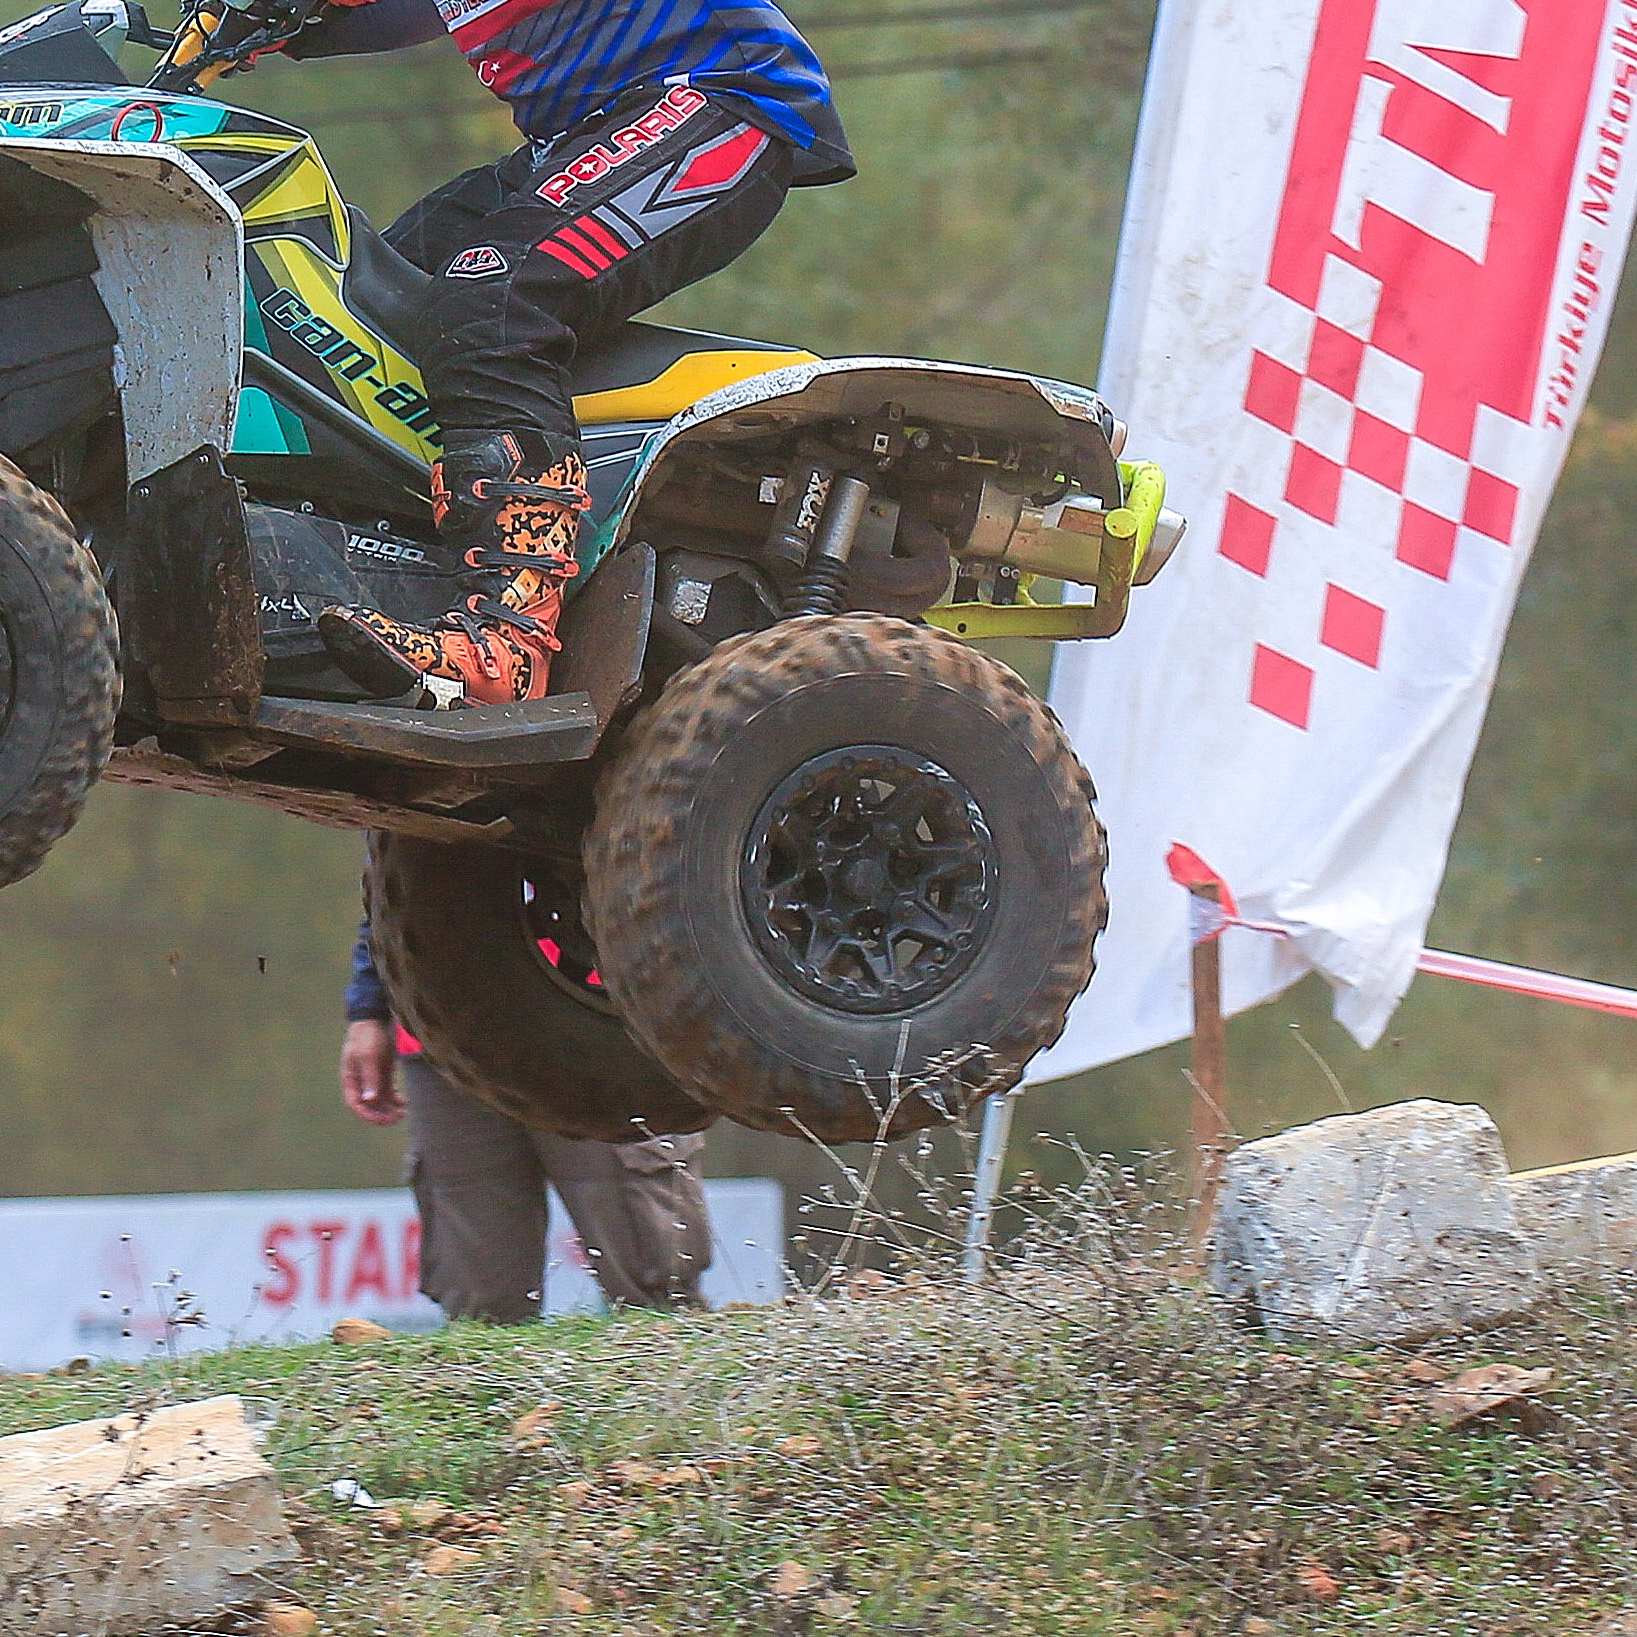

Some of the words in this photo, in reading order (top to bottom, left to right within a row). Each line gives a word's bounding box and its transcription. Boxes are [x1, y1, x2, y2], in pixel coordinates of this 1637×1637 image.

[535, 84, 709, 208] POLARIS
[1542, 241, 1602, 430] Türkiye
[347, 534, 425, 561] 1000
